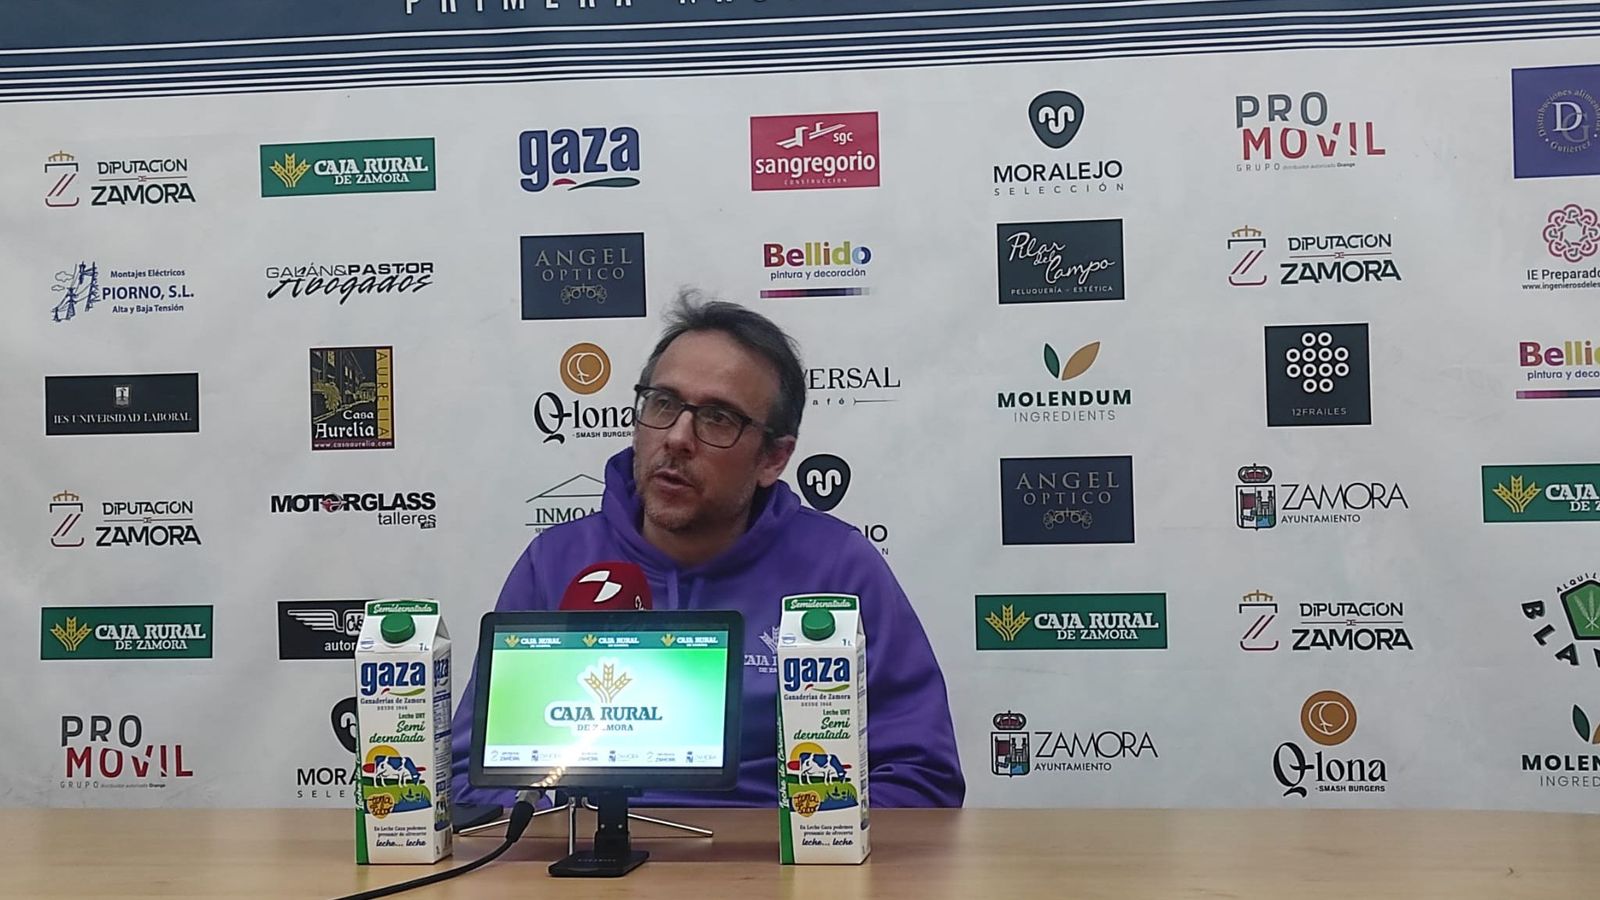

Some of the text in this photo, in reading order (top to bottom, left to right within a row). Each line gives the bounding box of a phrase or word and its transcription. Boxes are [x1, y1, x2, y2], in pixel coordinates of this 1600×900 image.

[1235, 91, 1328, 129] PRO
[833, 131, 853, 145] sgc
[314, 156, 428, 177] CAJA RURAL
[518, 126, 640, 193] gaza
[755, 150, 876, 178] sangregorio
[1236, 163, 1280, 171] GRUPO
[334, 172, 409, 185] DE ZAMORA
[994, 160, 1123, 183] MORALEJO
[91, 183, 196, 206] ZAMORA
[994, 183, 1125, 196] SELECCIÓN
[1007, 232, 1066, 261] Pilar
[534, 247, 632, 268] ANGEL
[763, 241, 872, 269] Bellido
[1033, 250, 1055, 265] del
[110, 268, 185, 280] Montajes Eléctricos
[770, 267, 866, 281] pintura y decoración
[1045, 255, 1115, 285] Campo
[1280, 259, 1401, 285] ZAMORA
[1527, 269, 1538, 280] IE
[102, 285, 194, 301] PIORNO, S.L.
[267, 274, 434, 305] Abogados
[1011, 285, 1113, 295] PELUQUERÍA ESTÉTICA
[112, 306, 128, 314] Alta
[136, 305, 152, 315] Baja
[154, 304, 184, 313] Tensión
[1527, 370, 1562, 381] pintura
[1566, 371, 1572, 380] y
[376, 351, 390, 437] AURELIA
[997, 389, 1132, 408] MOLENDUM
[53, 412, 192, 424] IES UNIVERSIDAD LABORAL
[343, 410, 374, 420] Casa
[1014, 409, 1116, 423] INGREDIENTS
[1291, 407, 1347, 417] 12FRAILES
[1016, 471, 1120, 490] ANGEL
[1280, 482, 1409, 510] ZAMORA
[1545, 484, 1596, 500] CAJA
[271, 492, 436, 513] MOTORGLASS
[1569, 502, 1591, 512] DE
[378, 512, 436, 525] talleres
[1281, 513, 1361, 524] AYUNTAMIENTO
[96, 525, 201, 547] ZAMORA
[1556, 572, 1600, 594] ALQUIL
[1034, 612, 1159, 630] CAJA RURAL
[95, 623, 206, 640] CAJA RURAL
[1057, 629, 1139, 640] DE ZAMORA
[115, 638, 187, 650] DE ZAMORA
[1291, 628, 1414, 651] ZAMORA
[744, 655, 770, 666] AJA
[360, 662, 426, 696] gaza
[784, 657, 850, 692] gaza
[550, 706, 663, 721] CAJA RURAL
[61, 714, 143, 747] PRO
[396, 720, 425, 733] Semi
[821, 717, 850, 730] Semi
[1034, 731, 1159, 759] ZAMORA
[1034, 762, 1112, 772] AYUNTAMIENTO
[60, 781, 99, 789] GRUPO
[1348, 785, 1386, 793] BURGERS
[406, 839, 427, 847] leche
[832, 838, 854, 846] leche
